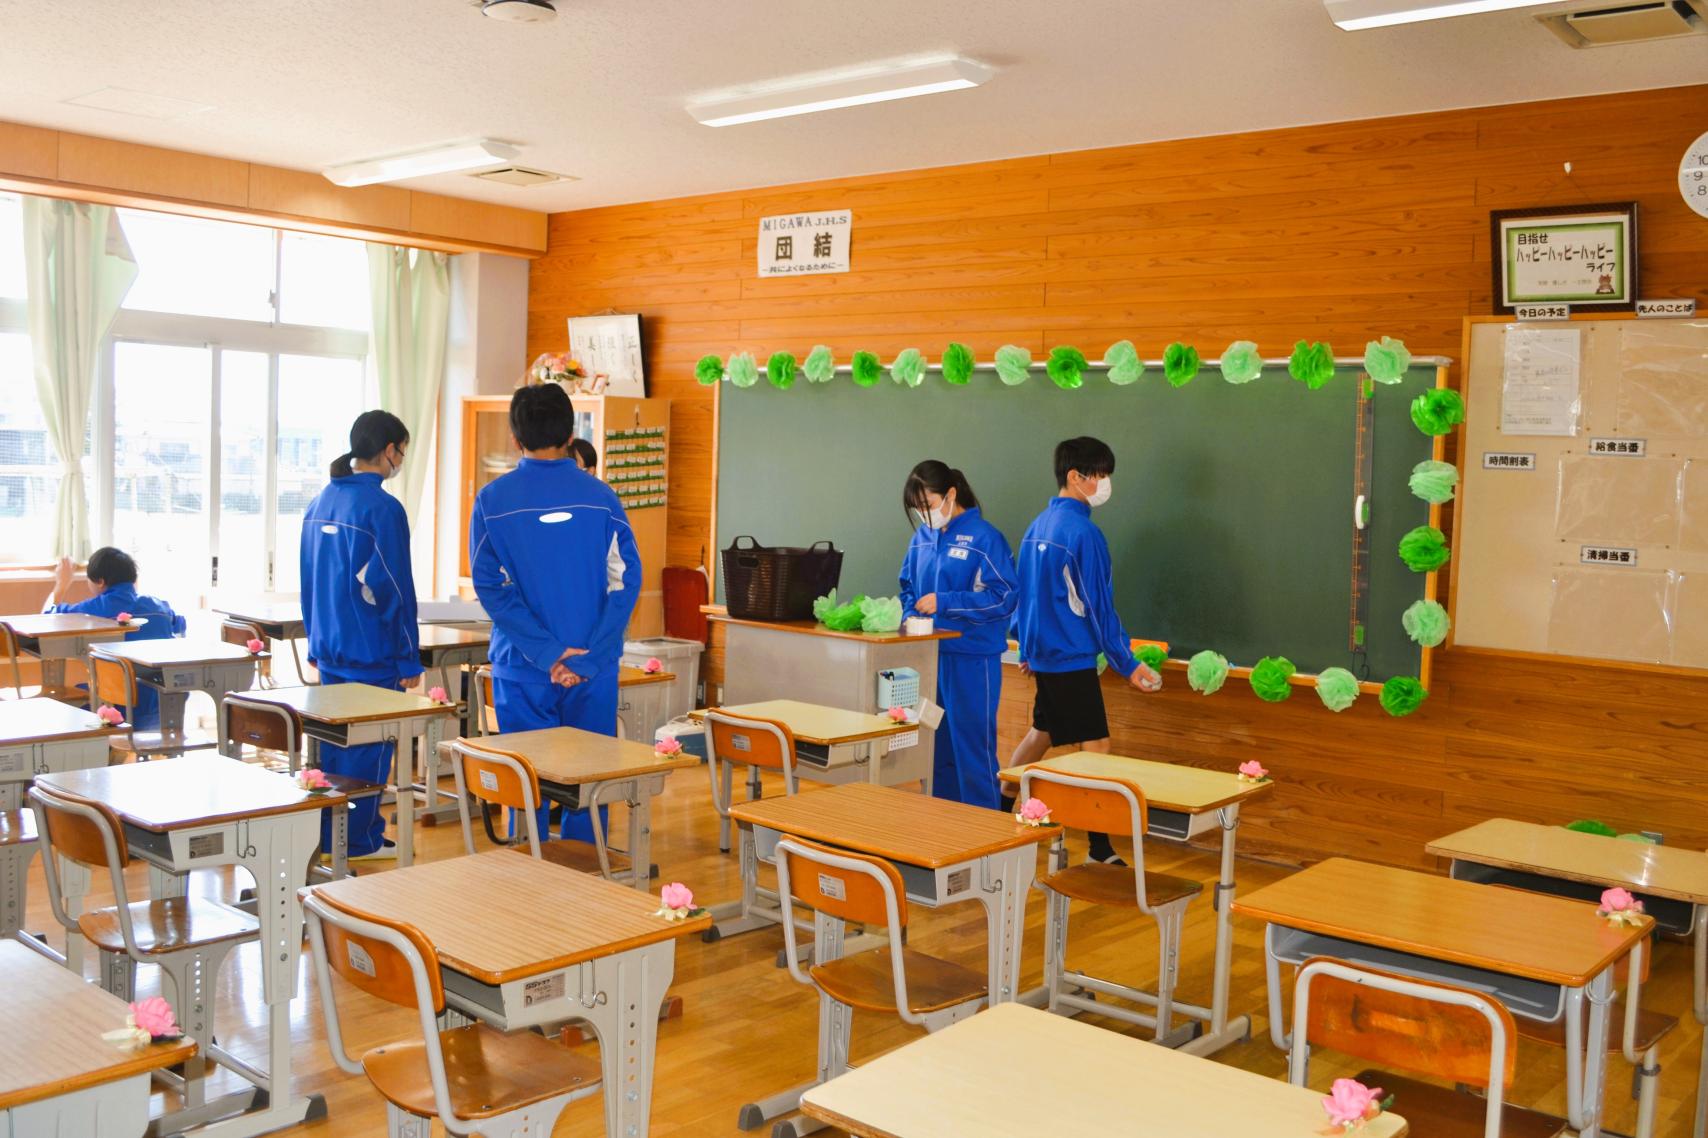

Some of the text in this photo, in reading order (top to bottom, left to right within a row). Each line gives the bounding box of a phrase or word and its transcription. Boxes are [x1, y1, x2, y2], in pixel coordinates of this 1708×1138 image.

[1693, 170, 1703, 181] 9
[1697, 185, 1707, 196] 8
[763, 217, 812, 231] MIGAWA
[1517, 233, 1548, 246] 目指せ
[1516, 243, 1614, 262] ハッピーハッピーハッピー
[1586, 262, 1616, 273] ライフ
[1519, 307, 1567, 318] 今日の予定
[1638, 303, 1694, 314] 先人のことば
[1595, 441, 1640, 453] 給食当番
[1488, 455, 1530, 467] 時間割表
[1587, 549, 1631, 562] 清掃当番
